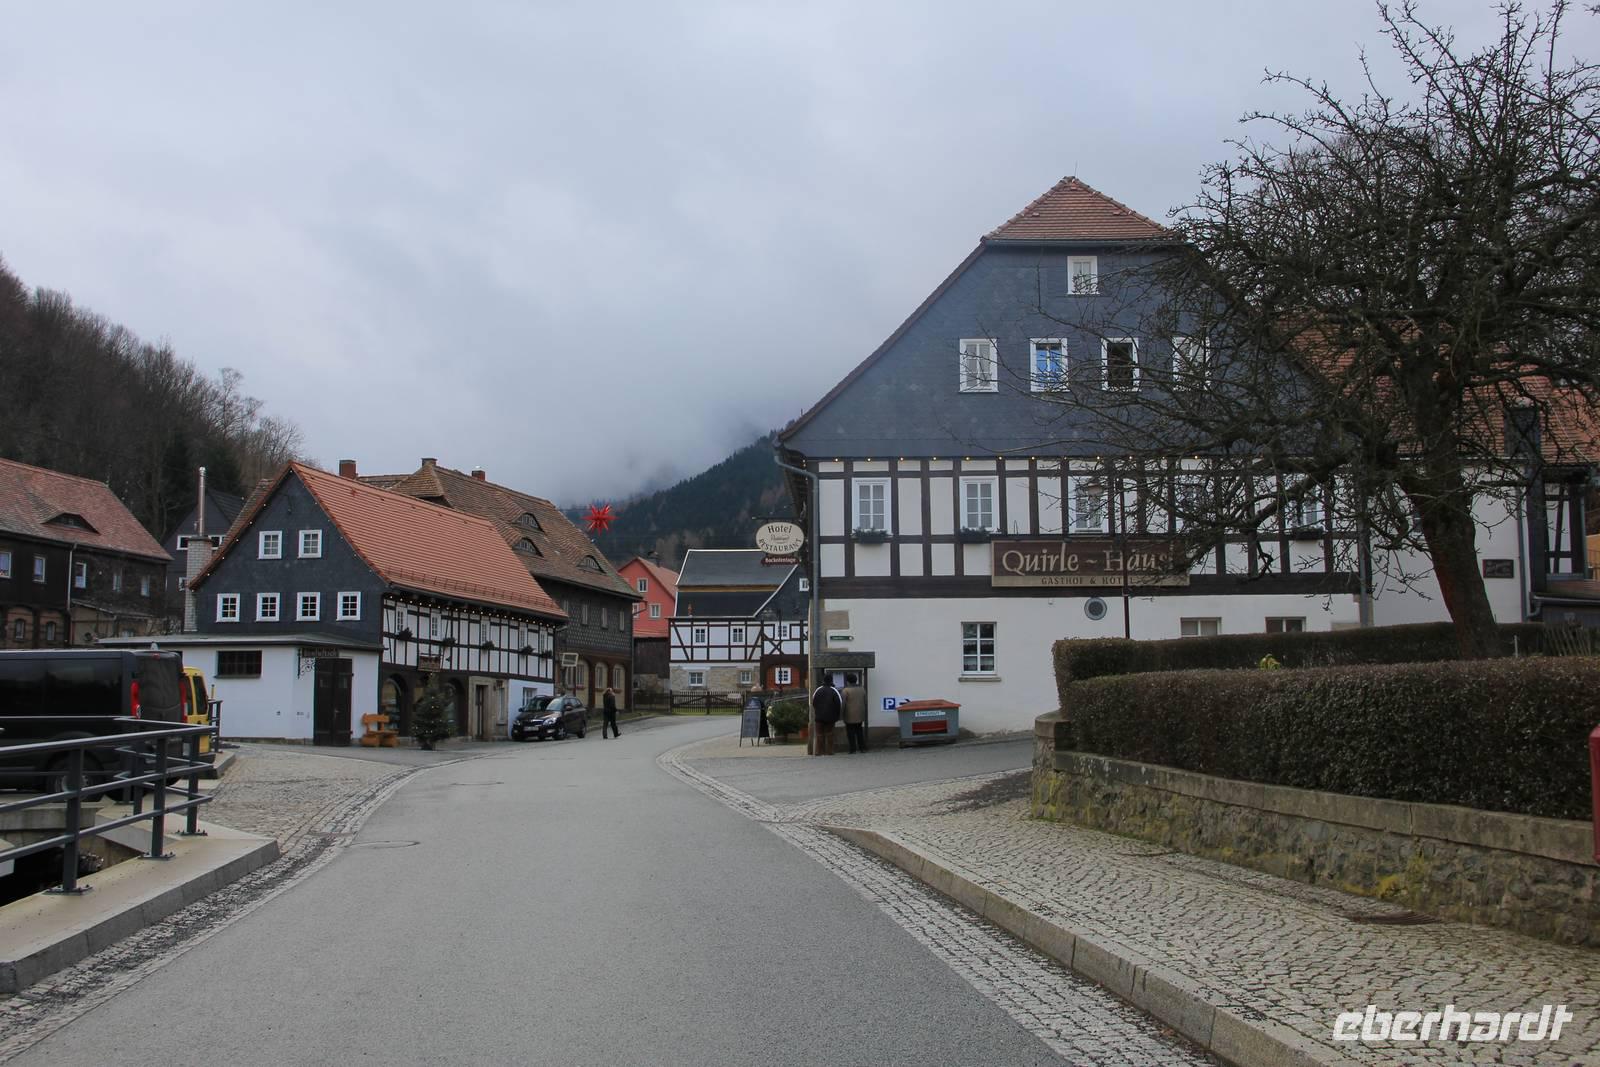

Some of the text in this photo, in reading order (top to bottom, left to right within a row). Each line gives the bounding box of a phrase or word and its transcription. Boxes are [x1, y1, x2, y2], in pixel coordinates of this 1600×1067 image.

[767, 525, 793, 534] Hotel
[758, 538, 802, 552] RESTAURANT
[1001, 542, 1080, 576] Quirle
[1041, 576, 1135, 585] GASTHOF & HOTL
